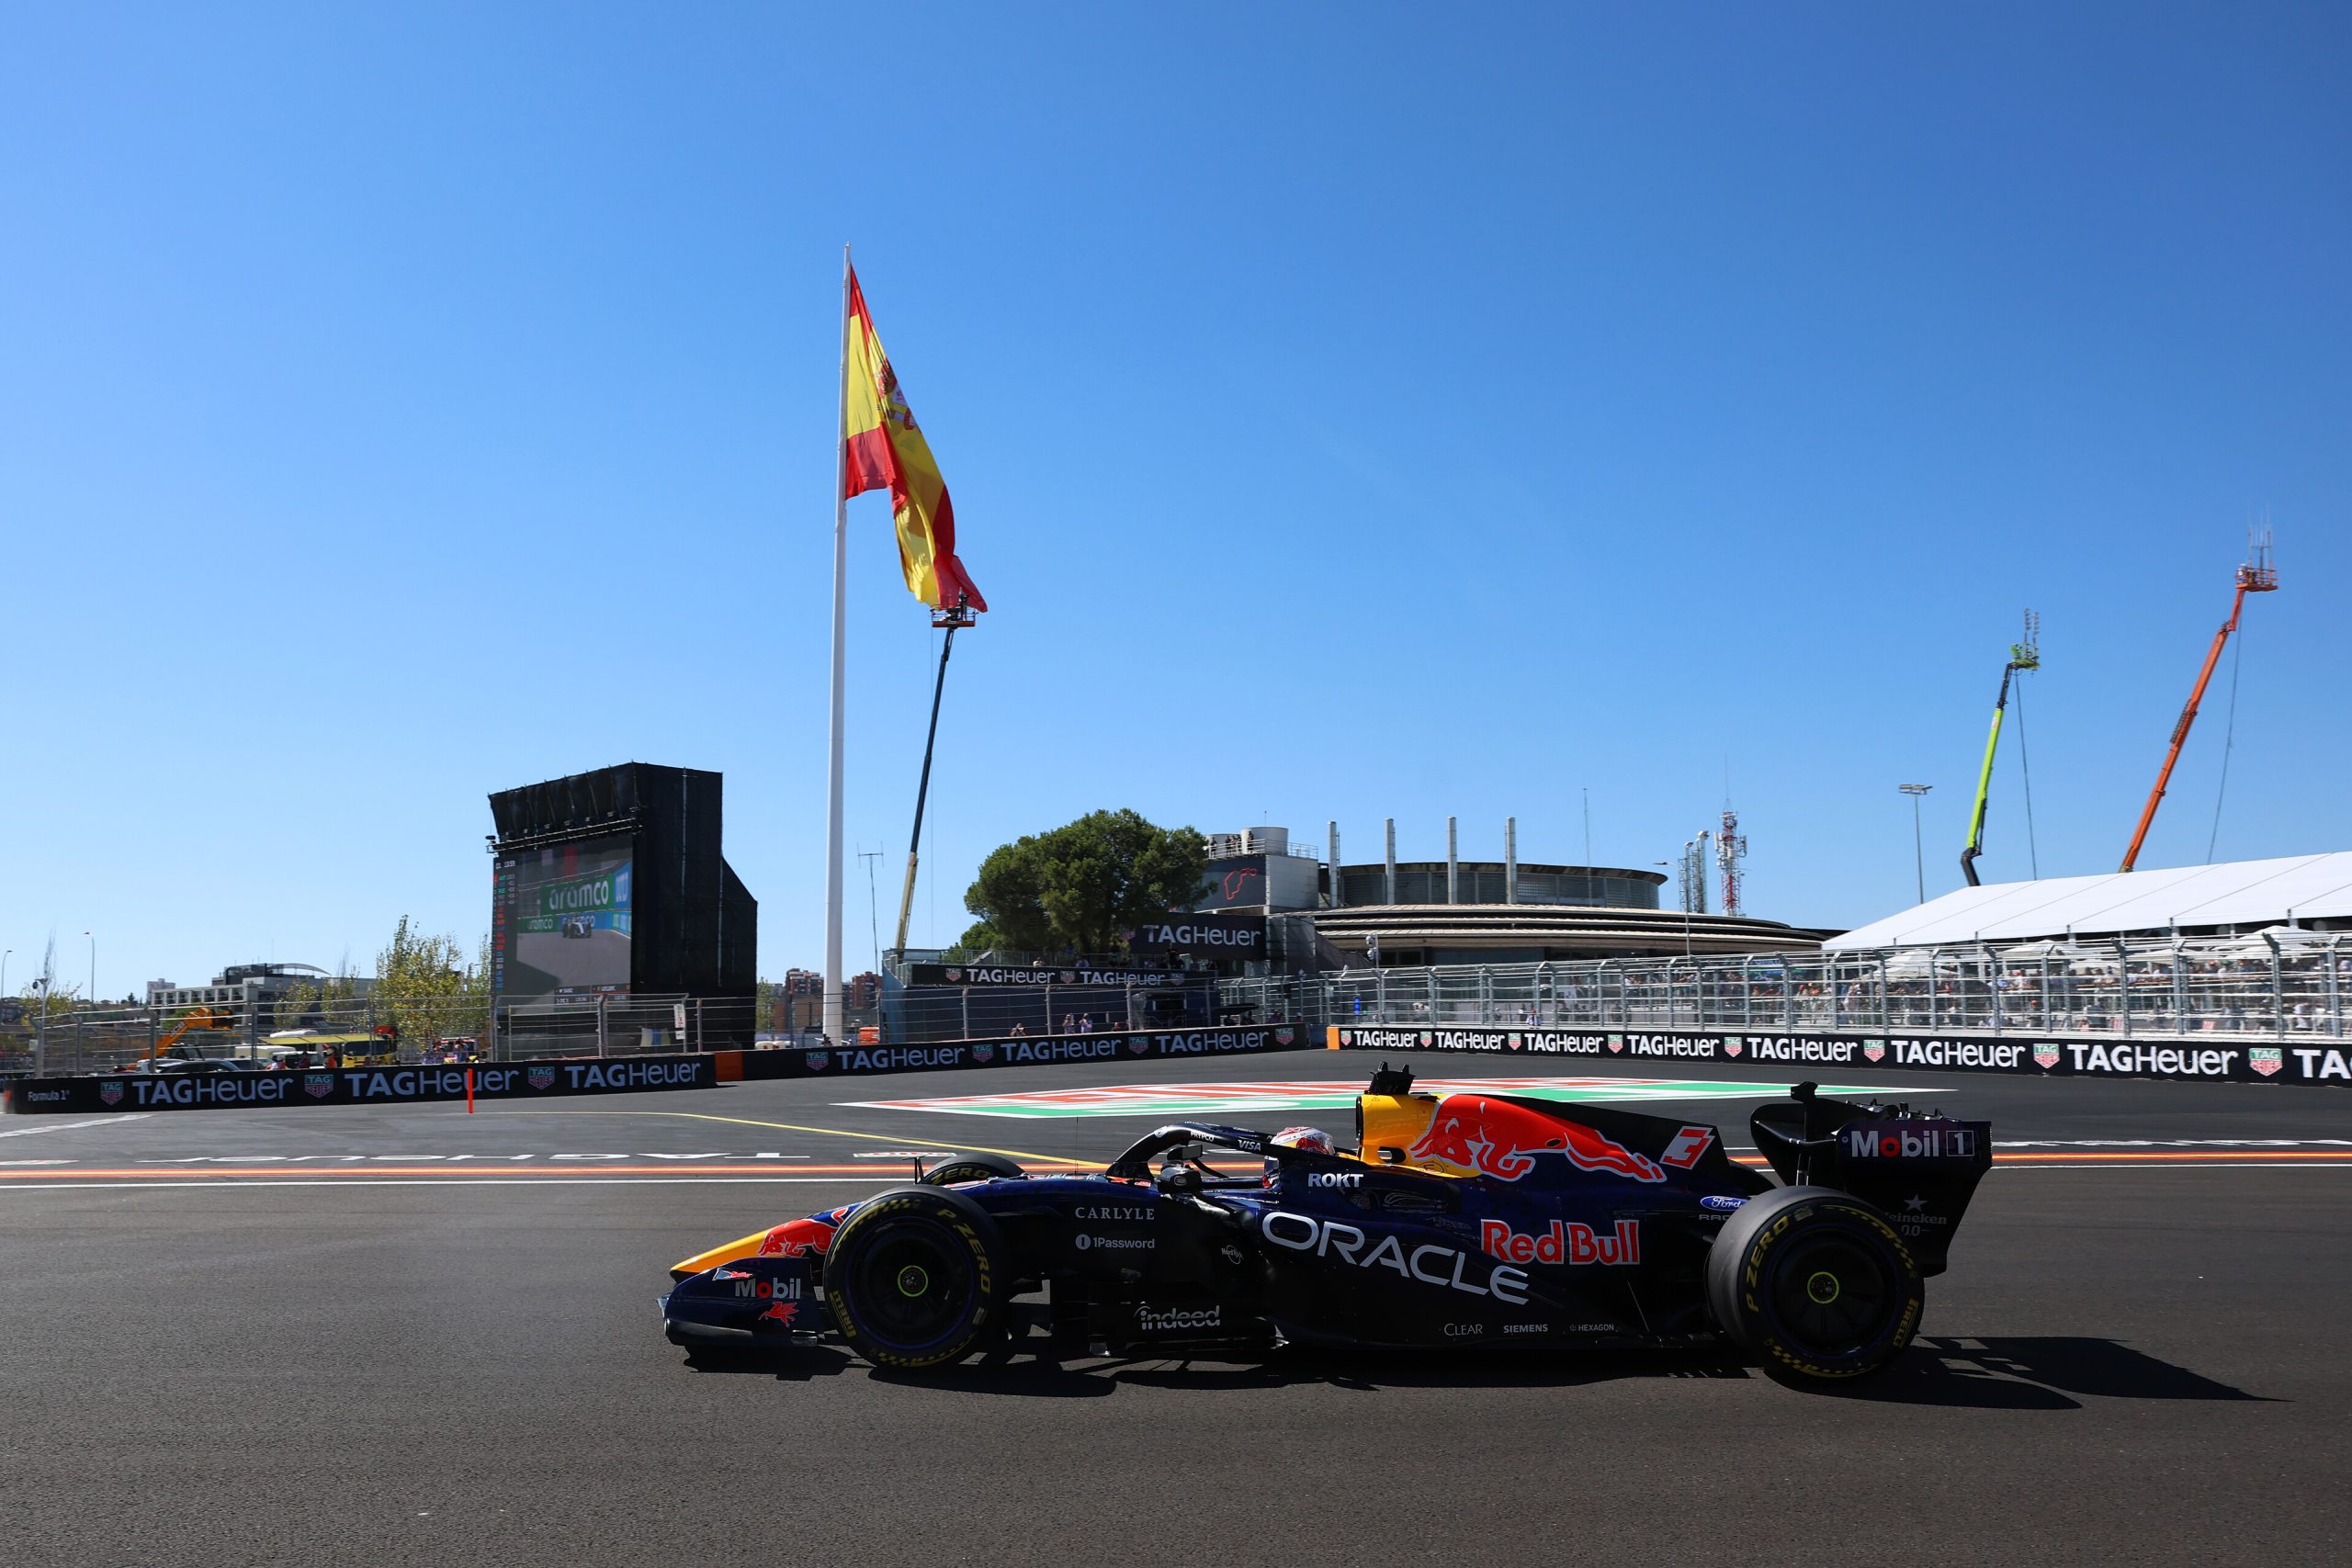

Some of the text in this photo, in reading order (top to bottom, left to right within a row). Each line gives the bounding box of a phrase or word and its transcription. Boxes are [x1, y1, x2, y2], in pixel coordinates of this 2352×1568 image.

[549, 880, 609, 909] aramco
[1143, 924, 1261, 946] TAGHeuer
[967, 968, 1056, 984] TAGHeuer
[1155, 1031, 1270, 1054] TAGHeuer
[1354, 1030, 1418, 1048] TAGHeuer
[1435, 1031, 1505, 1050] TAGHeuer
[1525, 1032, 1604, 1054] TAGHeuer
[1627, 1034, 1720, 1057] TAGHeuer
[1747, 1037, 1858, 1062] TAGHeuer
[836, 1046, 966, 1070] TAGHeuer
[1001, 1039, 1121, 1062] TAGHeuer
[1891, 1040, 2025, 1067] TAGHeuer
[2067, 1043, 2238, 1075] TAGHeuer
[2254, 1050, 2279, 1058] TAG
[2292, 1048, 2352, 1079] TA
[345, 1069, 519, 1096] TAGHeuer
[565, 1062, 701, 1089] TAGHeuer
[132, 1077, 294, 1103] TAGHeuer
[1190, 1129, 1216, 1143] PRYPCO
[1237, 1138, 1261, 1152] VISA
[1851, 1131, 1966, 1157] Mobil 1
[1659, 1126, 1715, 1169] 3
[931, 1168, 991, 1185] ZERO
[1308, 1173, 1364, 1188] ROKT
[1075, 1206, 1155, 1221] CARLYLE
[1711, 1196, 1743, 1209] Ford
[1698, 1213, 1728, 1222] RAC
[1887, 1212, 1948, 1225] eineken
[936, 1208, 992, 1294] P ZERO
[1093, 1236, 1155, 1249] 1Password
[1480, 1218, 1641, 1266] Red Bull
[1261, 1211, 1530, 1305] ORACLE
[1745, 1214, 1791, 1315] P ZERO
[735, 1278, 801, 1299] Mobil
[1135, 1304, 1221, 1330] indeed
[1577, 1323, 1615, 1332] HEXAGON
[1444, 1323, 1483, 1336] CLEAR
[1503, 1324, 1549, 1334] SIEMENS
